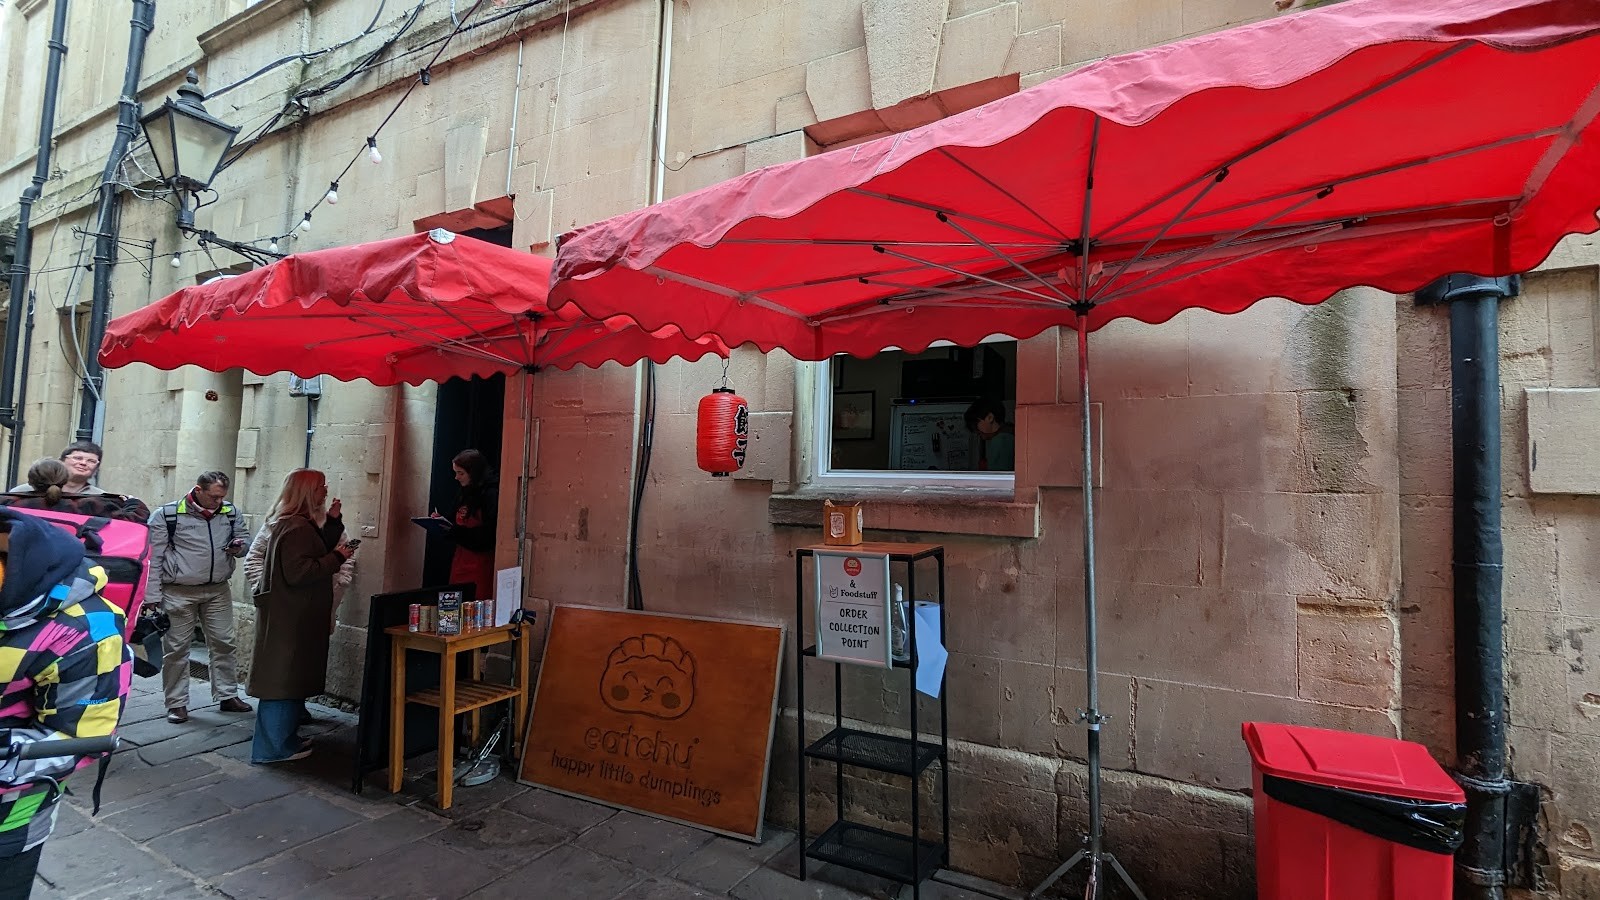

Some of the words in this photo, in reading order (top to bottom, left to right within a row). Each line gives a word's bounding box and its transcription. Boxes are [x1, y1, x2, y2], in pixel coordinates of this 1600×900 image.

[849, 580, 857, 588] &
[840, 589, 877, 599] Foodstuff
[840, 608, 868, 619] ORDER
[829, 622, 880, 635] COLLECTION
[841, 637, 868, 648] POINT
[585, 725, 693, 769] eatchu
[551, 749, 595, 778] happy
[600, 760, 635, 785] little
[639, 770, 721, 806] dumplings
